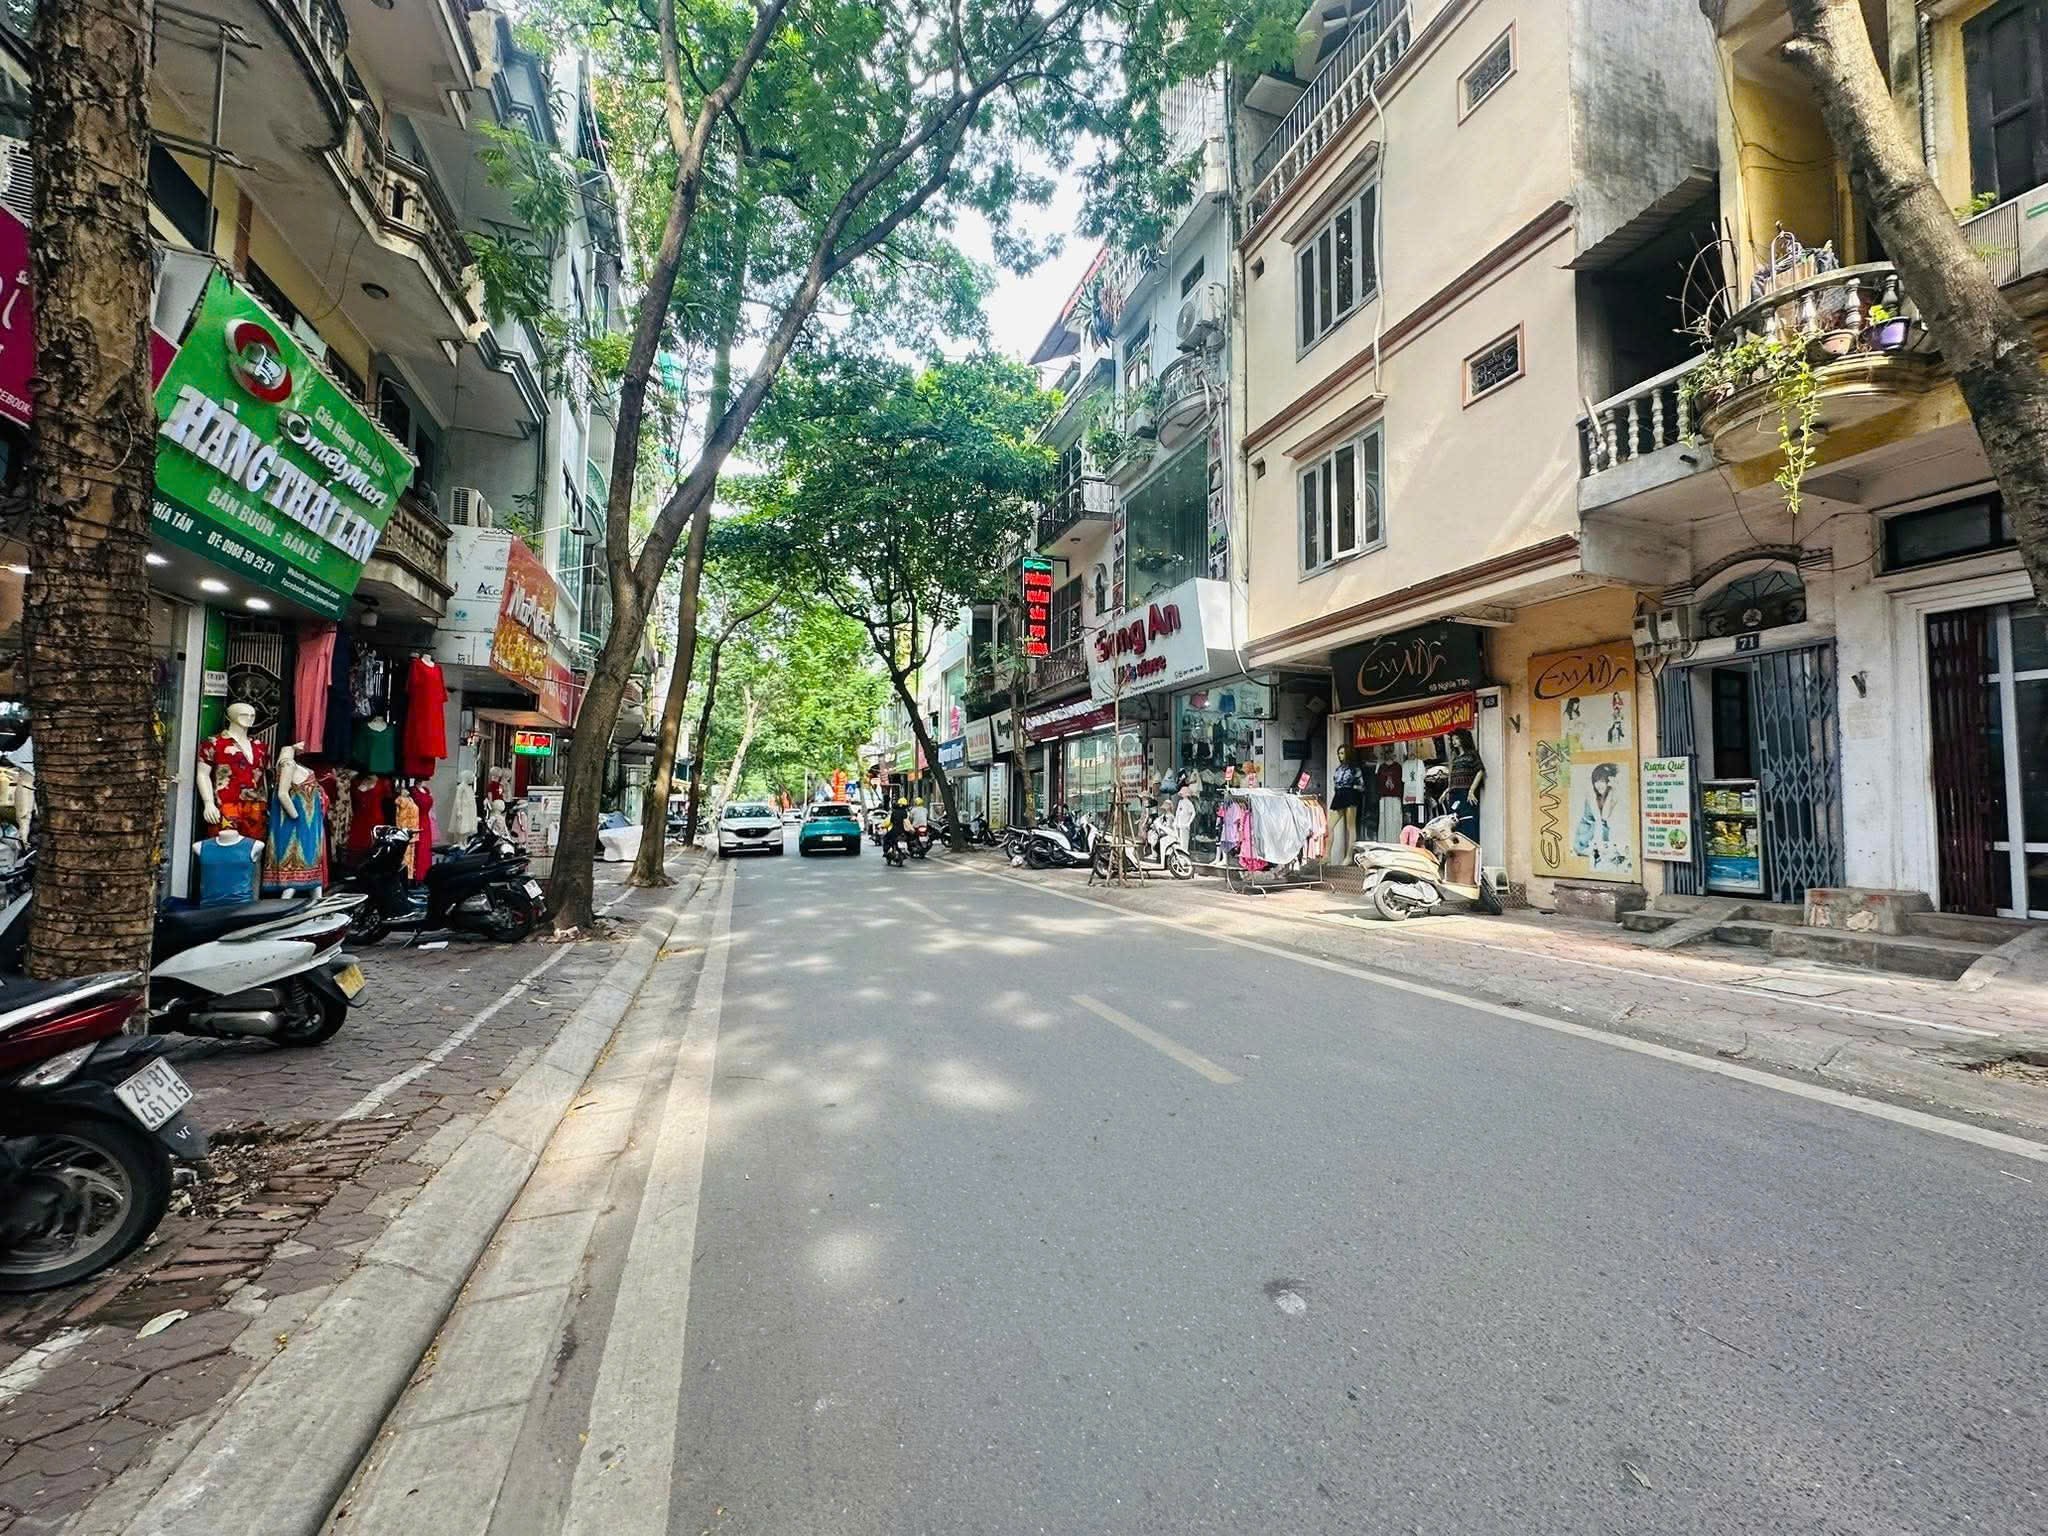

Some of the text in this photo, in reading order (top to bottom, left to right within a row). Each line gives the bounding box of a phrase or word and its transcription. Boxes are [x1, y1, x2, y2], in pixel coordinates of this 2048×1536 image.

[159, 384, 381, 565] HÀNG THÁI LAN
[172, 511, 194, 533] TÂN
[207, 486, 240, 516] BÁN
[238, 504, 276, 537] BUÔN
[281, 531, 307, 560] BÁN
[1148, 603, 1181, 641] An
[1739, 636, 1754, 649] 71
